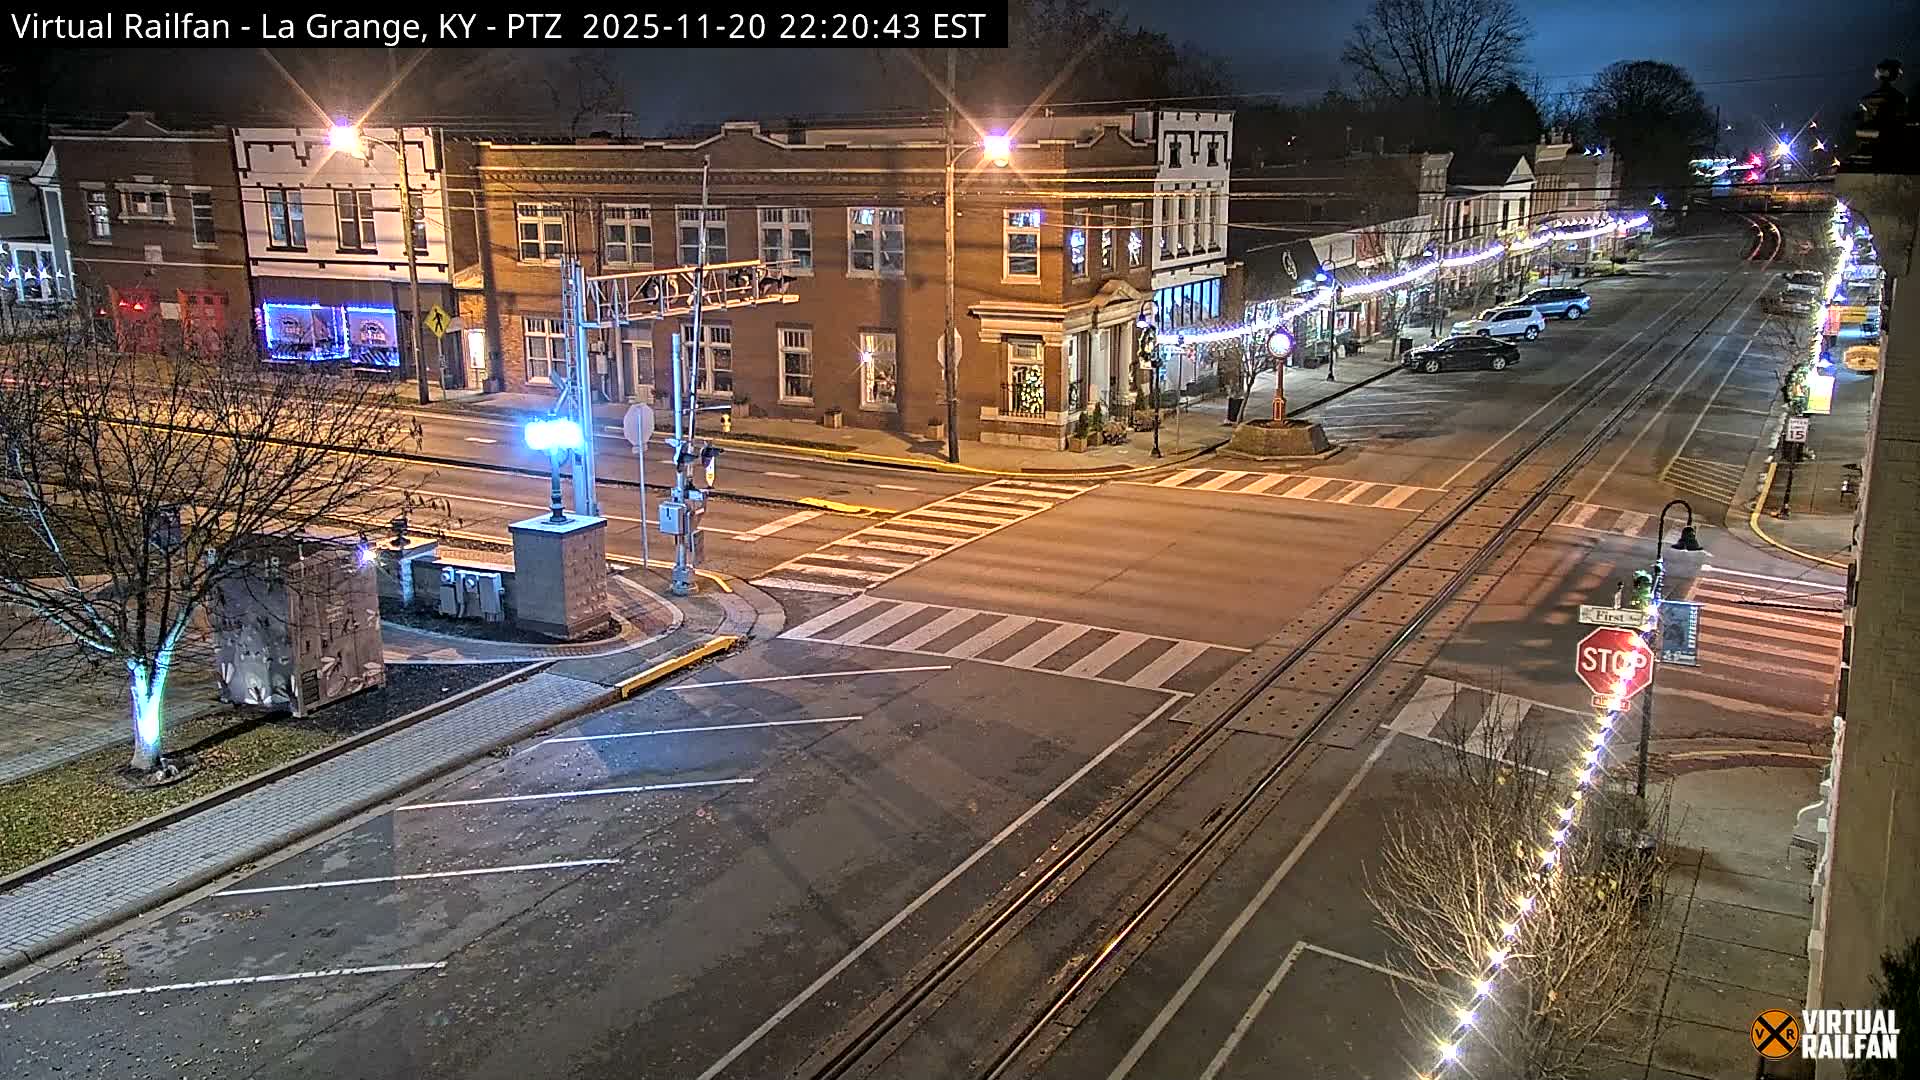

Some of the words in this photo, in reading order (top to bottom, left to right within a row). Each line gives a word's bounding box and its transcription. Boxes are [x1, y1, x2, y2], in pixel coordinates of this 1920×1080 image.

[1790, 430, 1805, 440] 15
[1596, 610, 1624, 622] First
[1581, 646, 1648, 677] STOP
